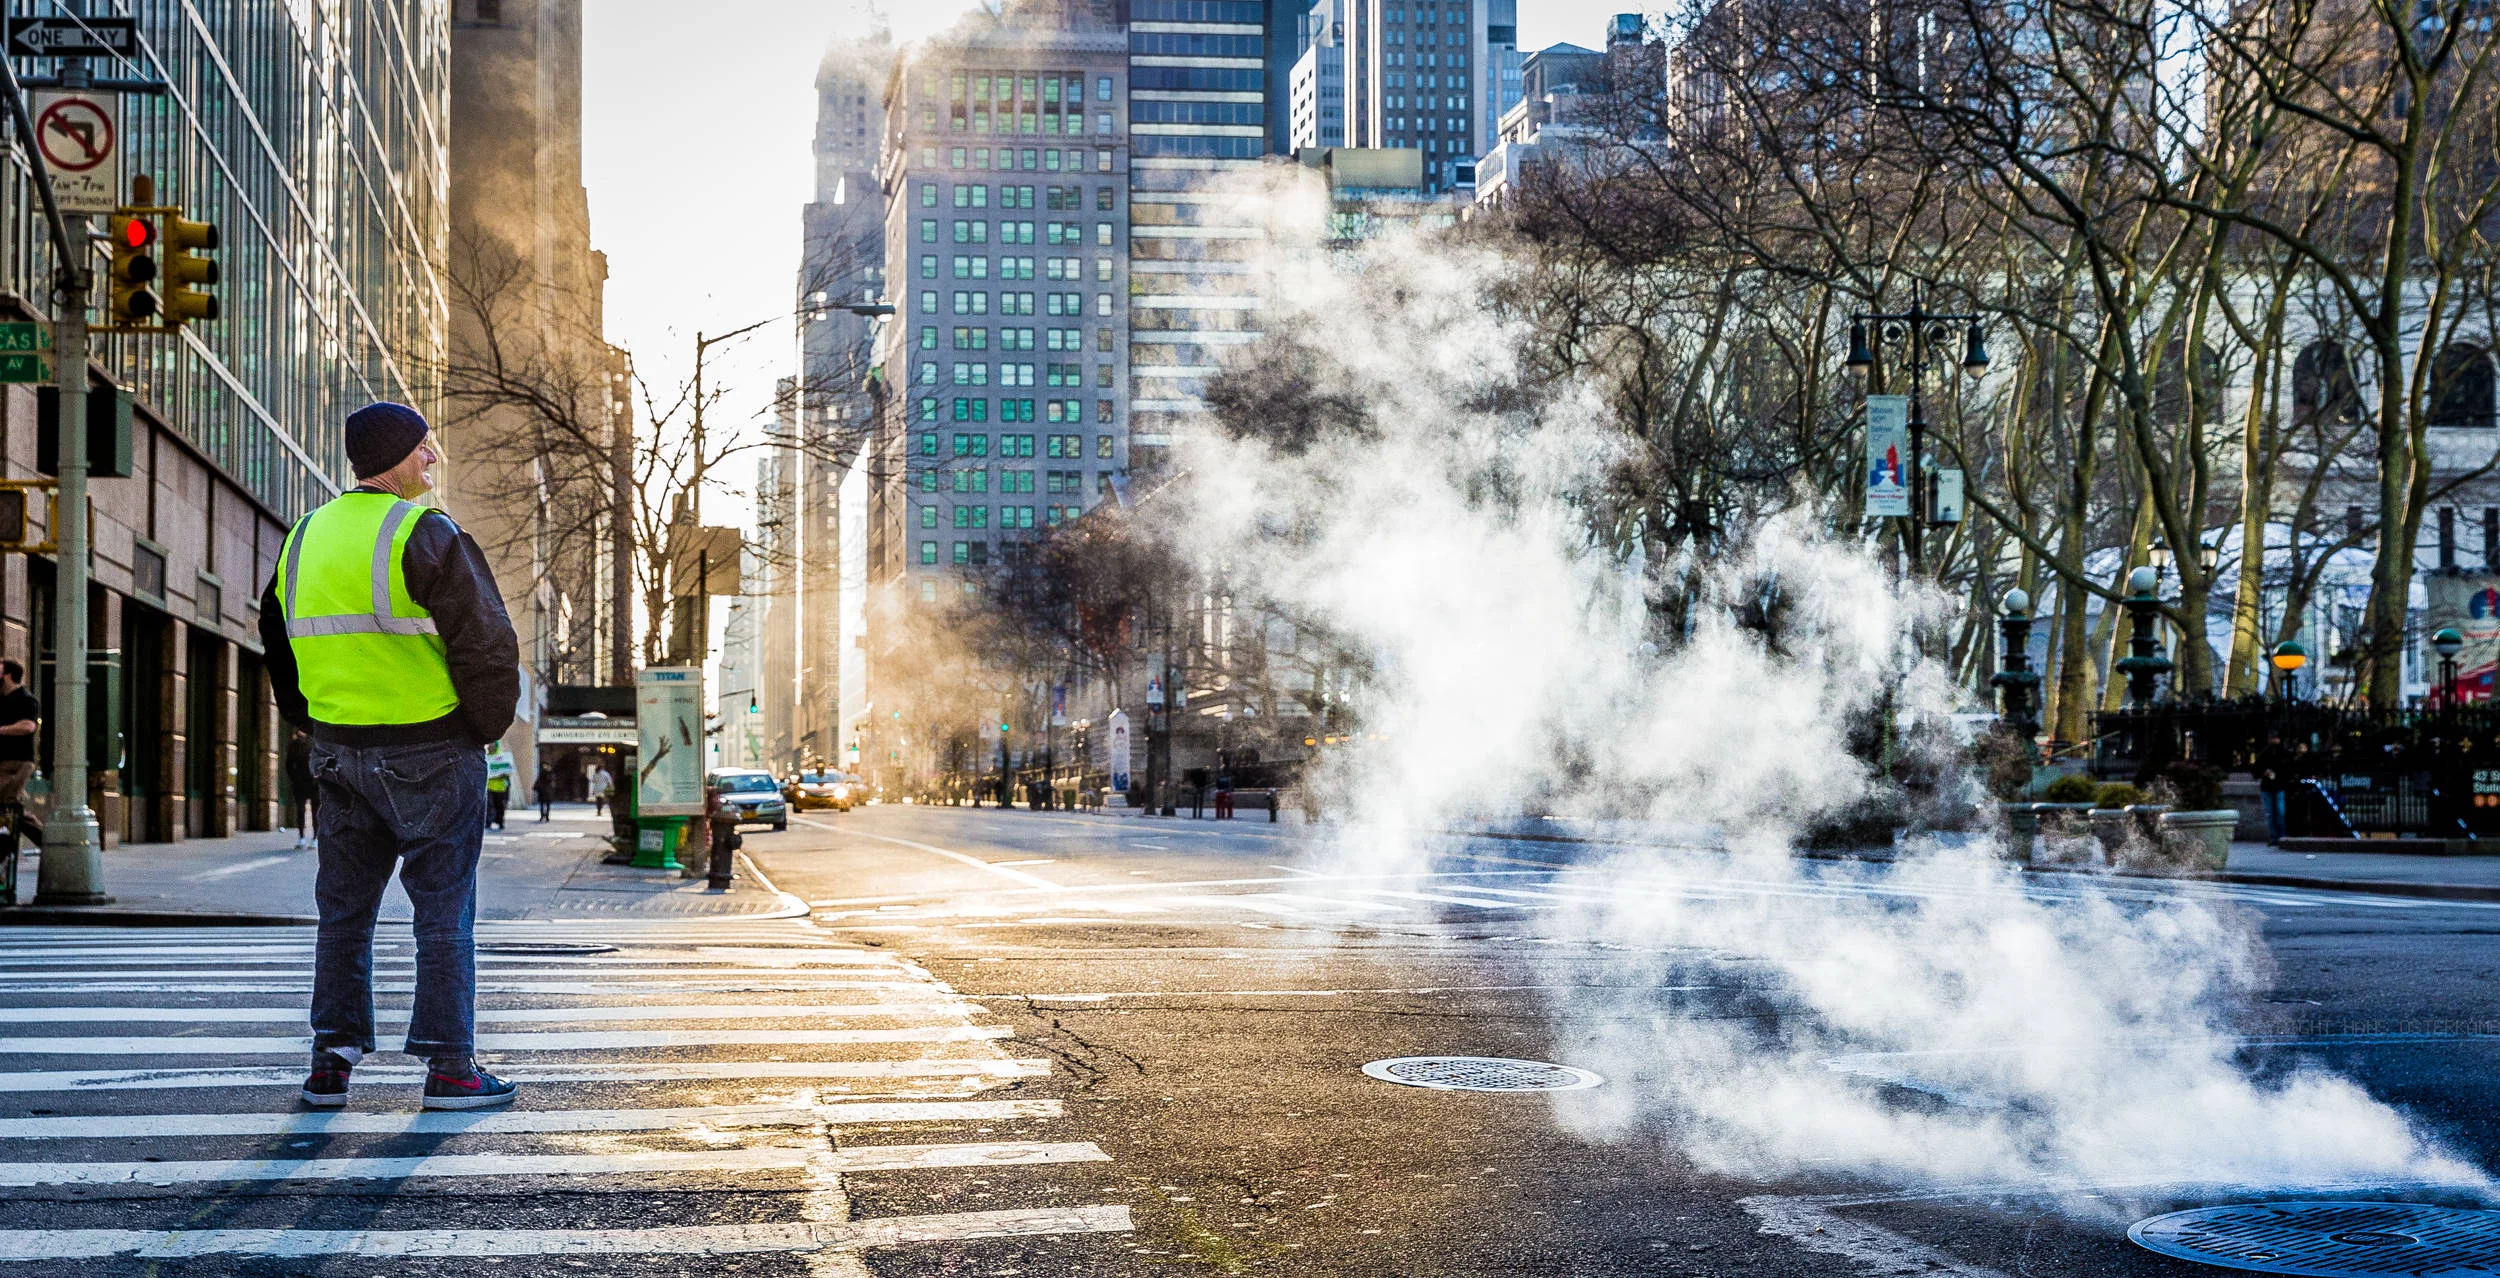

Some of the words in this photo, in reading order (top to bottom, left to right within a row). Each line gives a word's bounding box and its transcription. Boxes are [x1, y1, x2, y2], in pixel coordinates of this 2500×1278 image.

[28, 29, 63, 45] ONE
[81, 29, 119, 45] WAY
[7, 357, 24, 369] AV
[654, 671, 685, 681] TITAN
[2340, 773, 2373, 790] Subway
